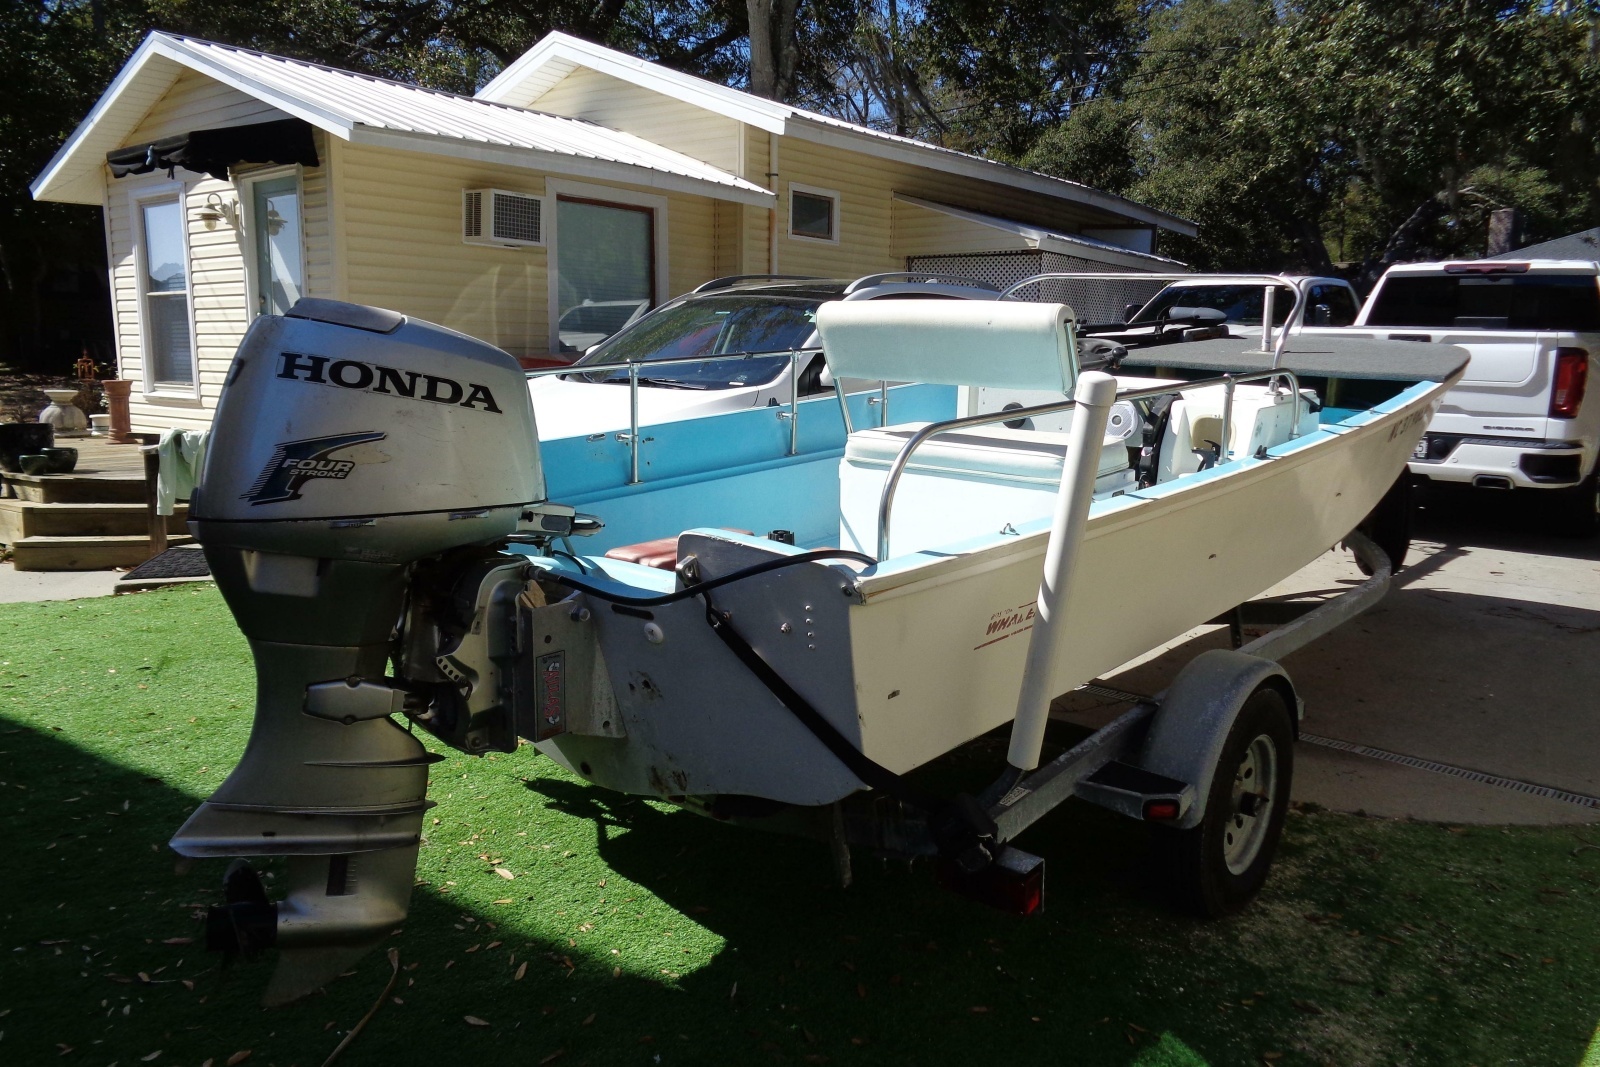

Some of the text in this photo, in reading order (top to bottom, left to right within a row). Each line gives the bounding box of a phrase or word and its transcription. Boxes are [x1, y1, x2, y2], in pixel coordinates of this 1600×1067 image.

[277, 352, 503, 414] HONDA
[281, 458, 354, 472] FOUR
[289, 468, 347, 478] STROKE
[986, 608, 1036, 635] WHALE
